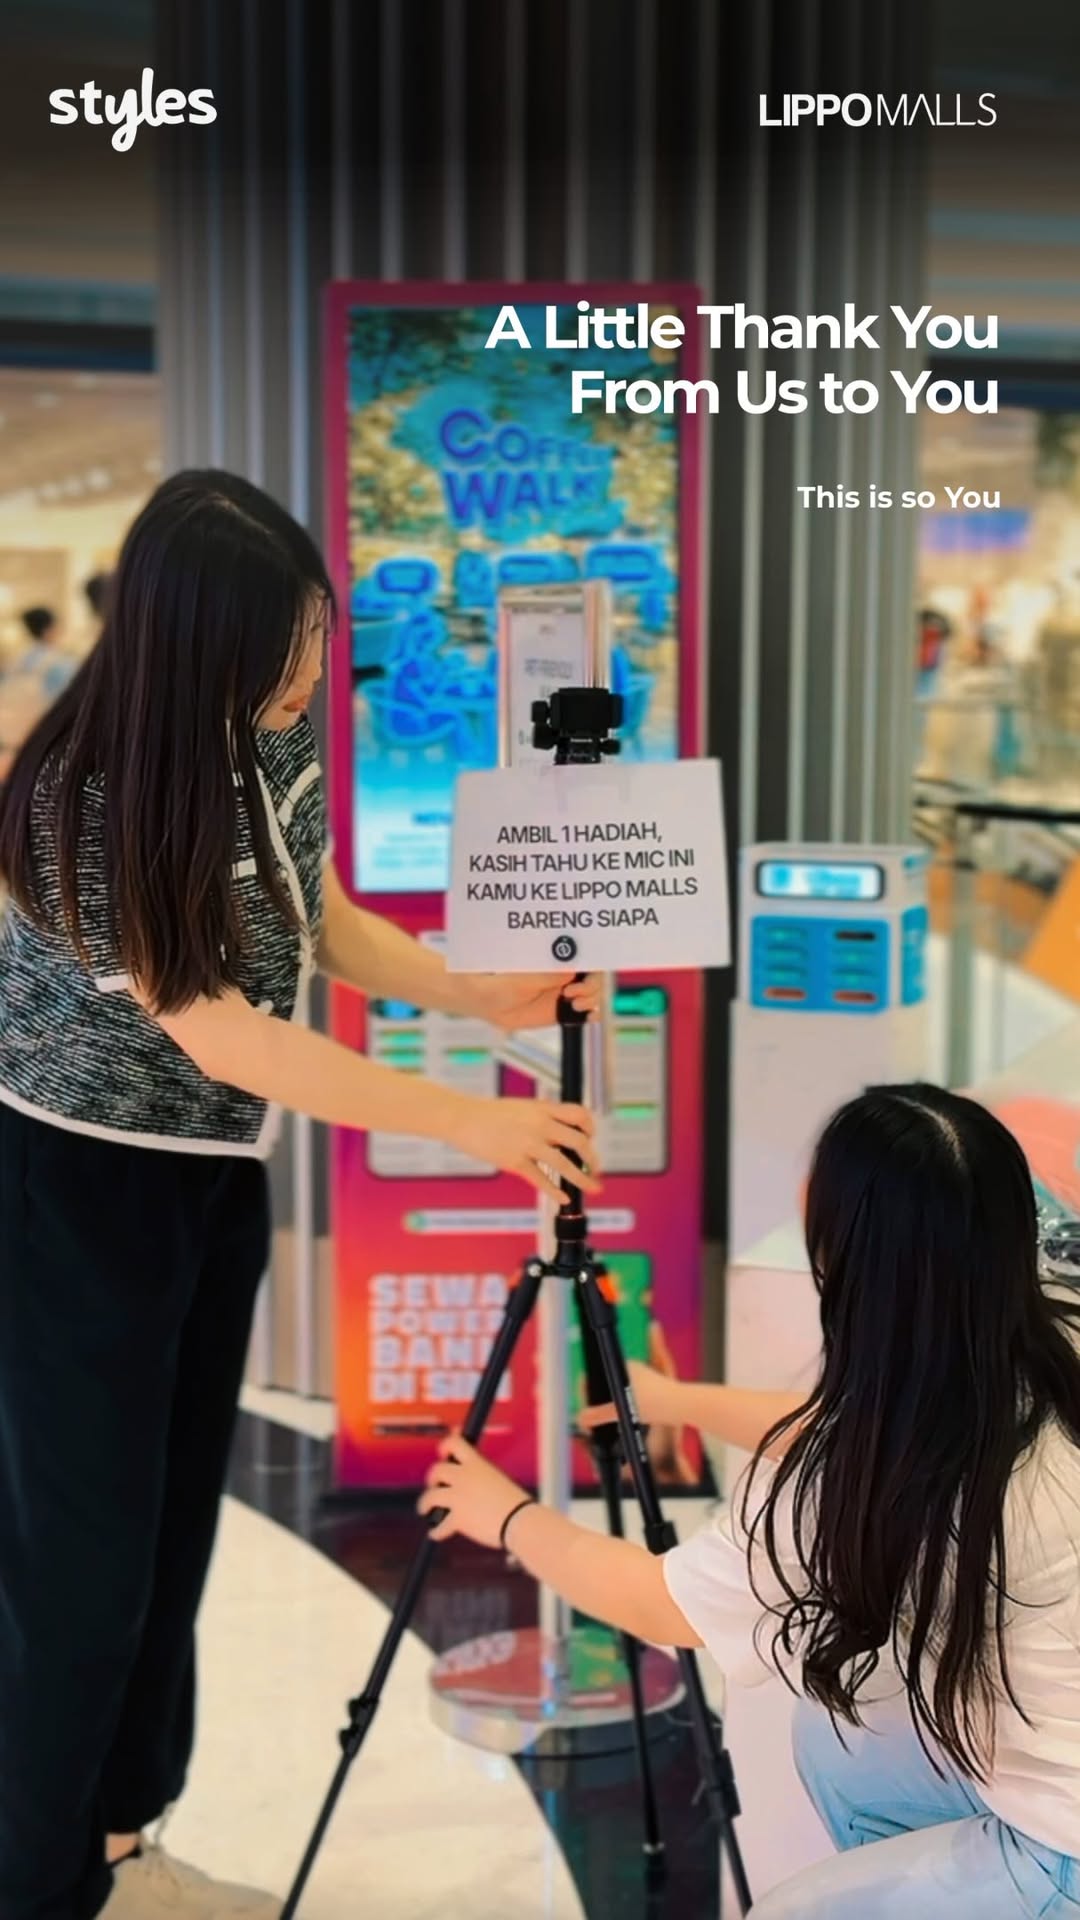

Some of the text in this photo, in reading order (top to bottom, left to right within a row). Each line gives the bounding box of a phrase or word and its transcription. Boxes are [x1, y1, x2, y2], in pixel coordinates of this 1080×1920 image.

[497, 821, 663, 844] AMBIL 1 HADIAH,
[469, 848, 695, 872] KASIH TAHU KE MIC INI
[466, 877, 698, 901] KAMU KE LIPPO MALLS
[507, 907, 660, 930] BARENG SIAPA
[368, 1273, 508, 1307] SEWA
